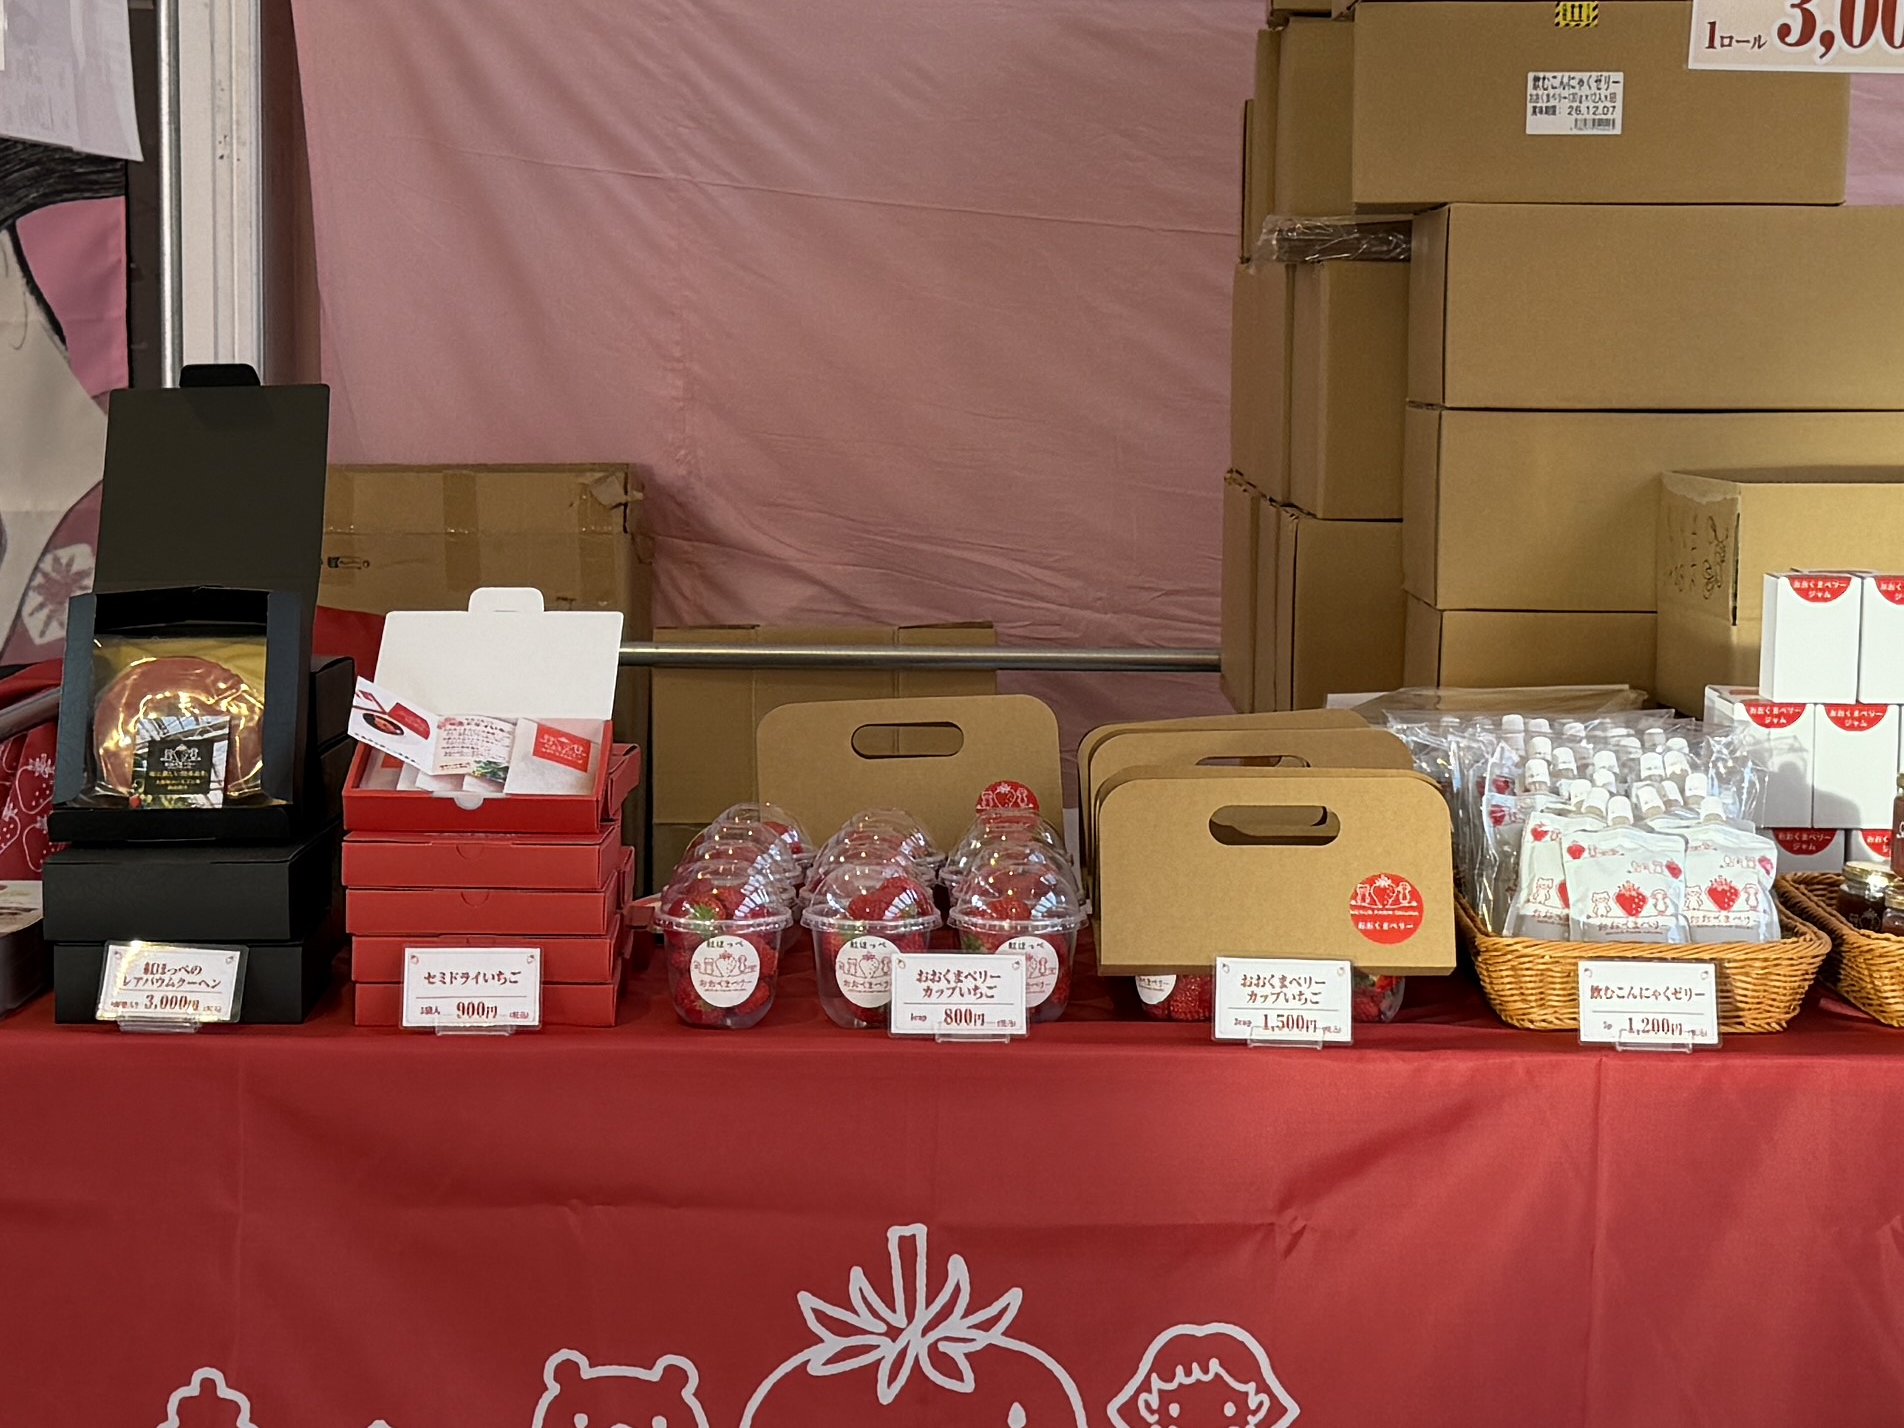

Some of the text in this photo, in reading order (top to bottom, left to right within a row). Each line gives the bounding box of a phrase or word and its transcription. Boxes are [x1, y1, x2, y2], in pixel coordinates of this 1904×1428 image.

[1704, 21, 1767, 50] 1ロール
[1532, 74, 1621, 91] 飲むこんにゃくゼリー
[1567, 105, 1616, 116] 26.12.07
[123, 976, 221, 989] レアバウムクーヘン
[424, 970, 522, 985] セミドライいちご
[916, 969, 1001, 984] おおくまベリー
[1240, 974, 1326, 989] おおくまベリー
[922, 985, 997, 1000] カップいちご
[1246, 990, 1322, 1005] カップいちご
[1590, 985, 1705, 1001] 飲むこんにゃくゼリー
[456, 1001, 497, 1019] 900円
[944, 1008, 985, 1026] 800円
[1262, 1014, 1317, 1033] 1,500円
[1628, 1017, 1683, 1036] 1,200円
